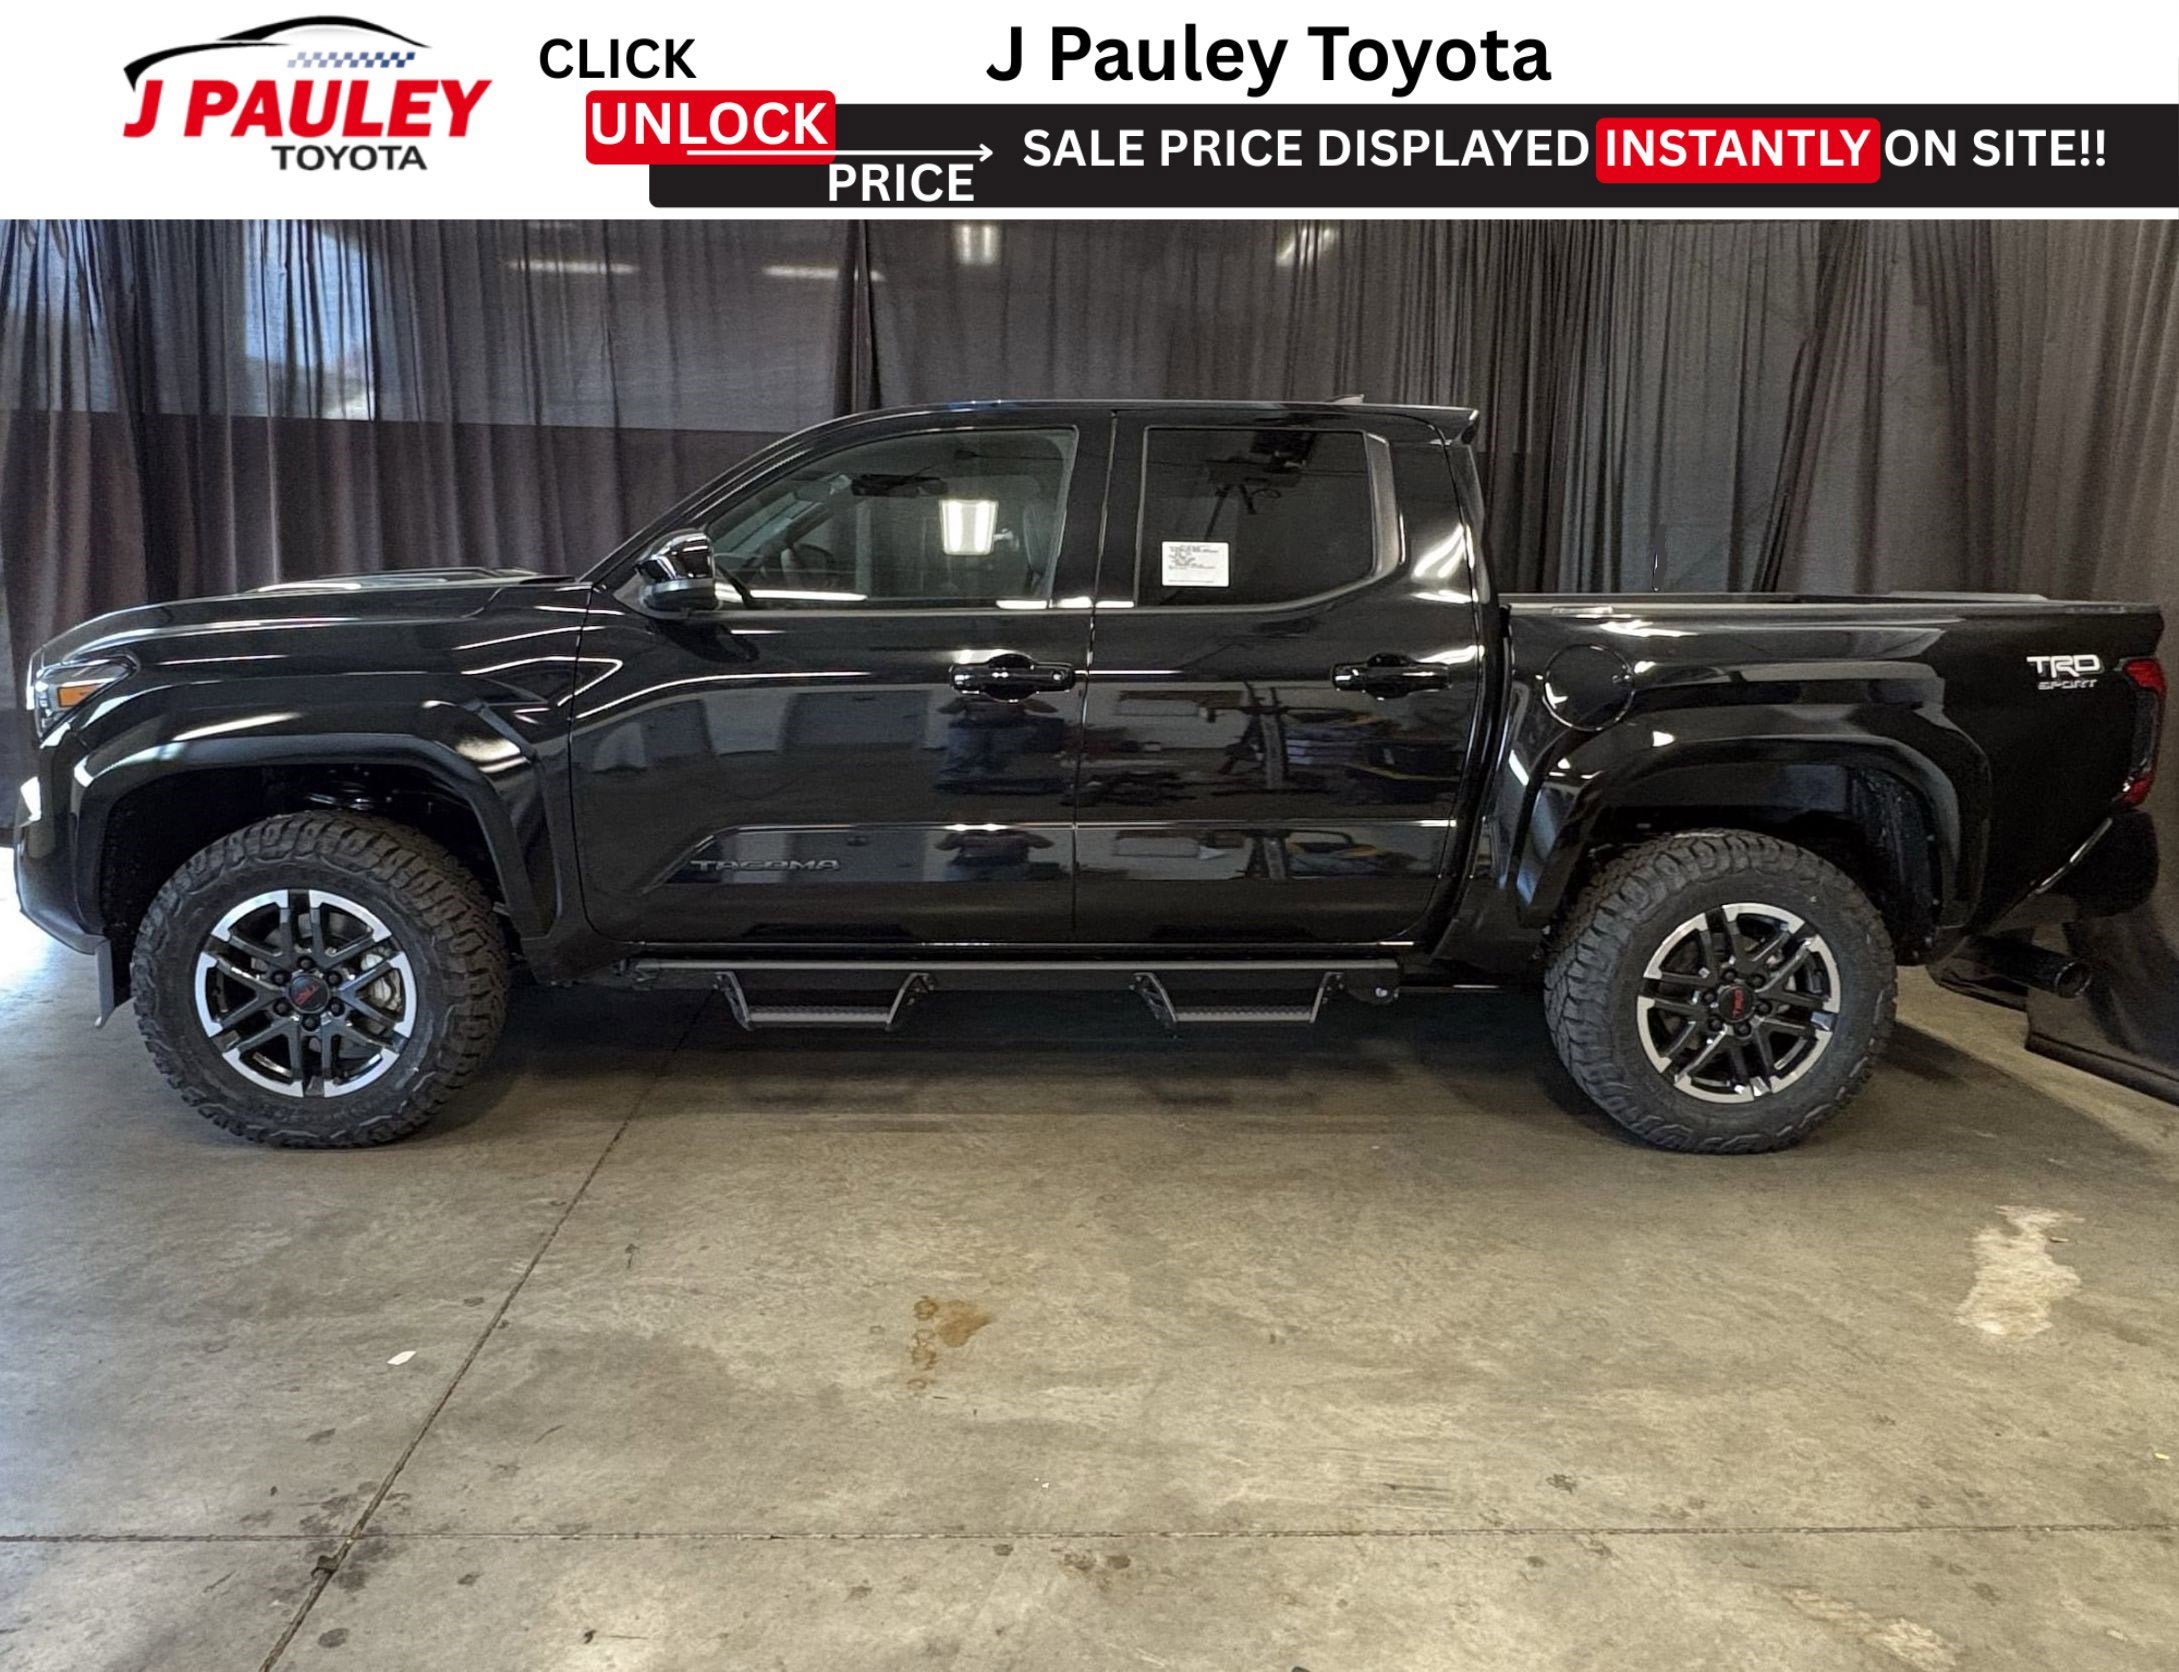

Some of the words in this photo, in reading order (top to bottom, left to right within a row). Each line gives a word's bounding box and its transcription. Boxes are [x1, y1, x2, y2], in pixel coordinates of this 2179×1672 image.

[2026, 654, 2102, 679] TRD
[2038, 679, 2097, 690] SPORT
[690, 859, 840, 872] TACOMA
